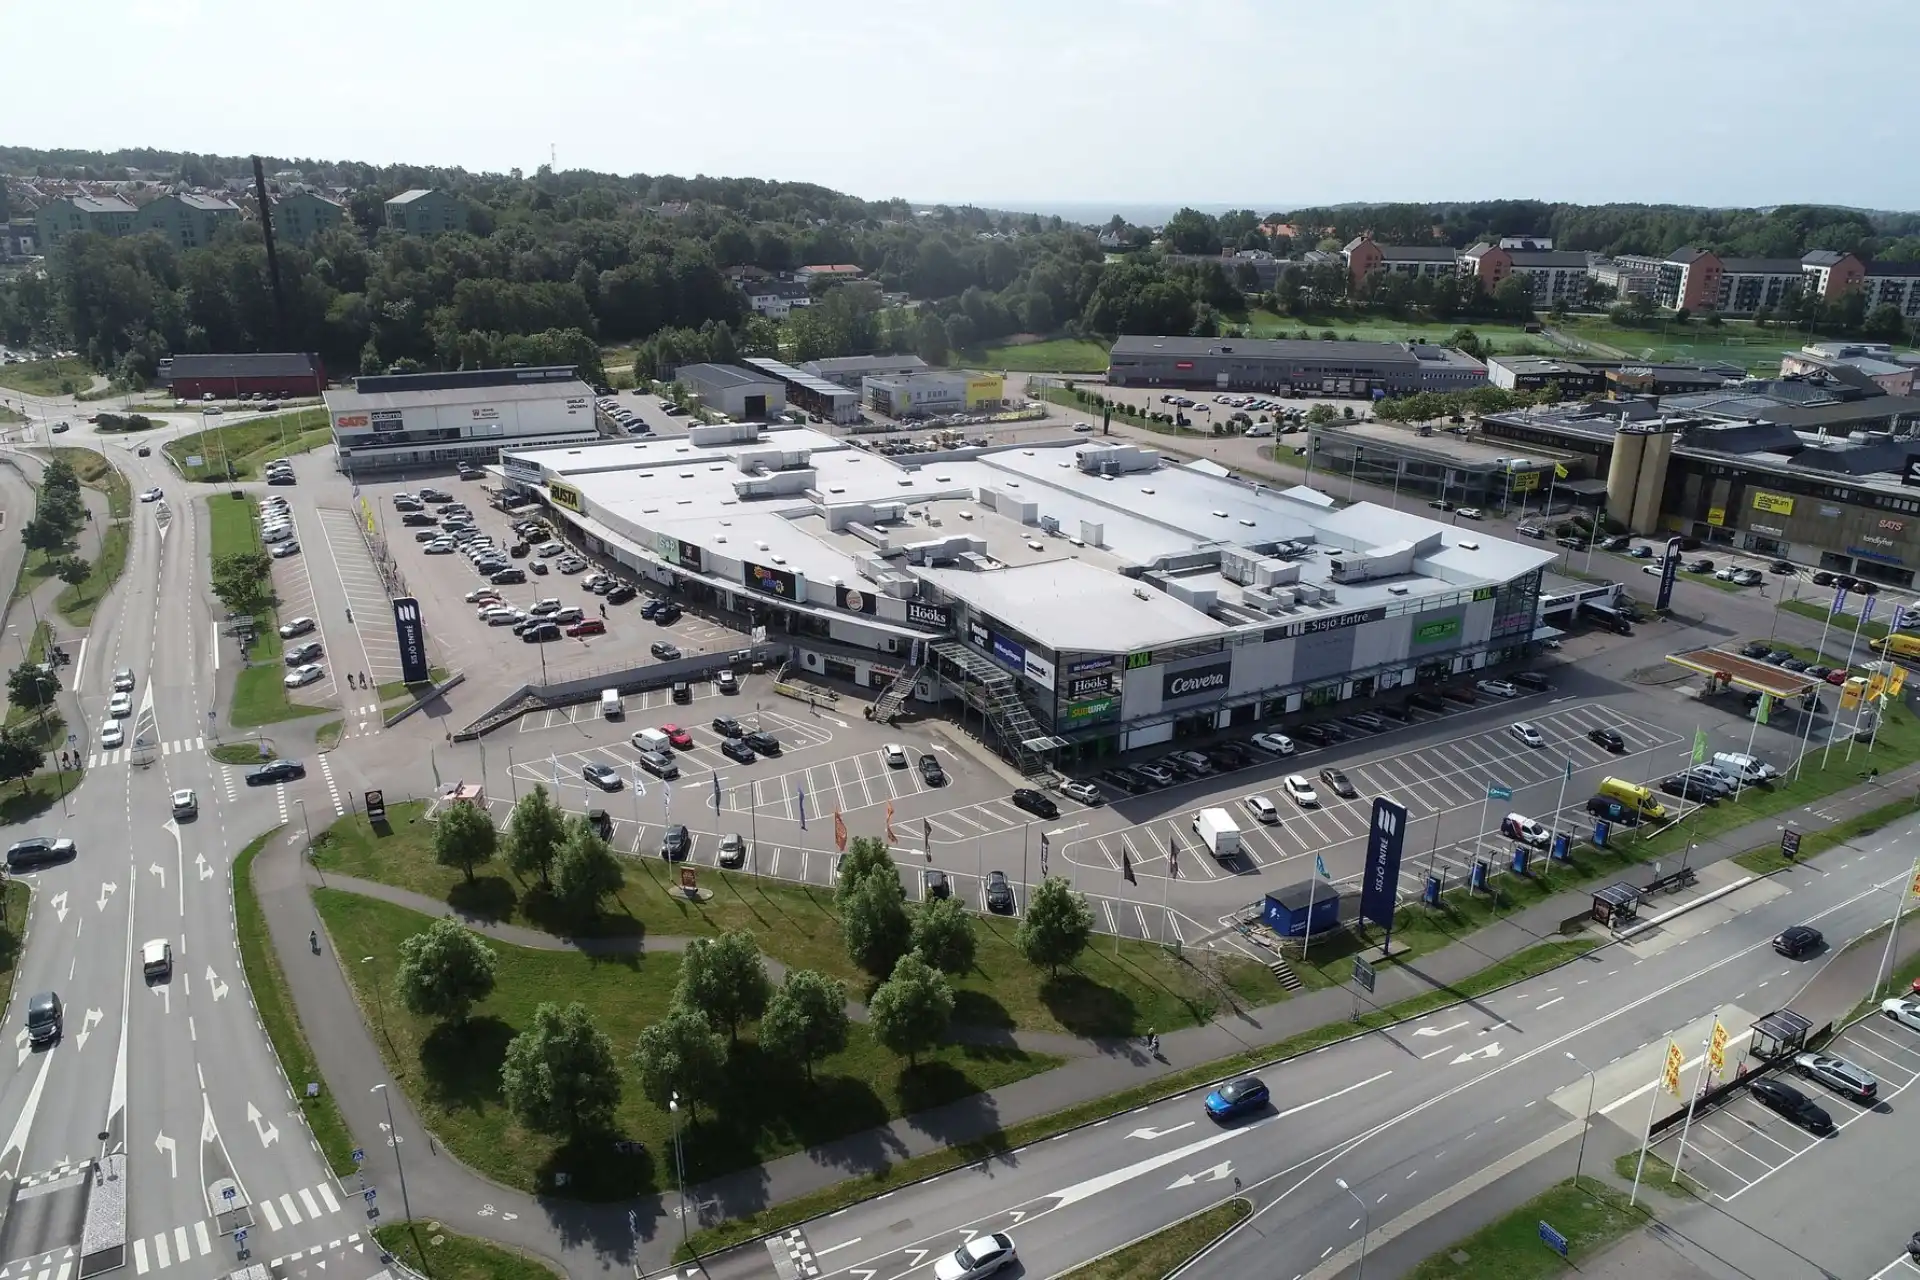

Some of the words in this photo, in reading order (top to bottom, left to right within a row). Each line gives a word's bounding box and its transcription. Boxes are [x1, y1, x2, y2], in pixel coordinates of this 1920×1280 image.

[337, 416, 368, 428] SATS
[550, 484, 578, 507] RUSTA
[1759, 495, 1789, 507] stadium
[1878, 519, 1902, 531] SATS
[1475, 587, 1492, 599] XXL
[909, 604, 947, 623] Hööks
[1311, 617, 1337, 631] Sisjö
[1128, 653, 1150, 669] XXL
[1074, 676, 1108, 693] Hööks
[1170, 672, 1224, 695] Cervera
[1071, 701, 1110, 718] SUBWAY
